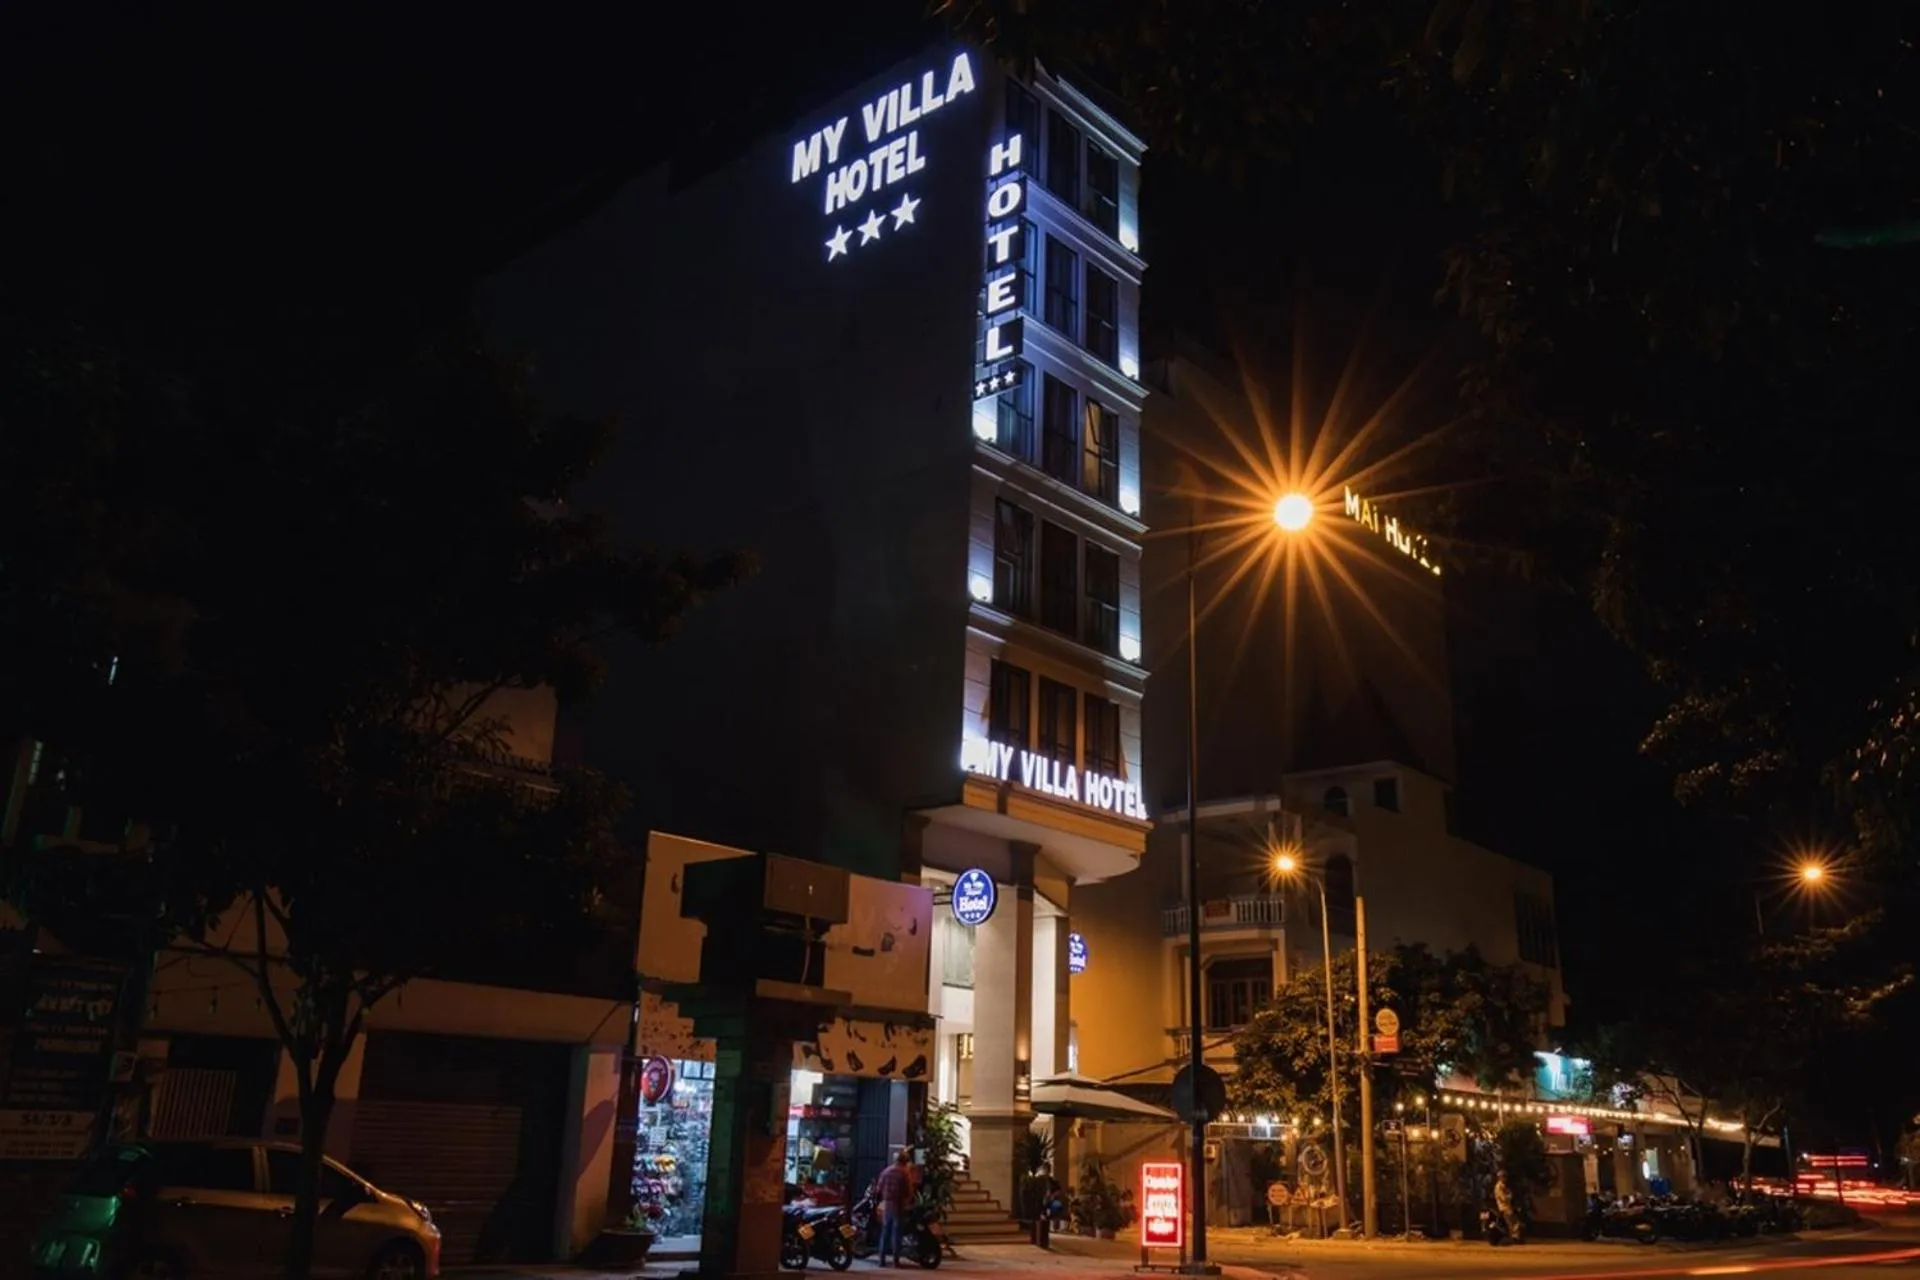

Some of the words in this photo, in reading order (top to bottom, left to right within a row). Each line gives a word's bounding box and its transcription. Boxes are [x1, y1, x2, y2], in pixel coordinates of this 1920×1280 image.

[792, 116, 848, 183] MY
[862, 52, 976, 143] VILLA
[825, 130, 926, 215] HOTEL
[986, 133, 1022, 361] HOTEL
[980, 739, 1014, 781] MY
[1021, 750, 1080, 800] VILLA
[1085, 770, 1149, 820] HOTEL
